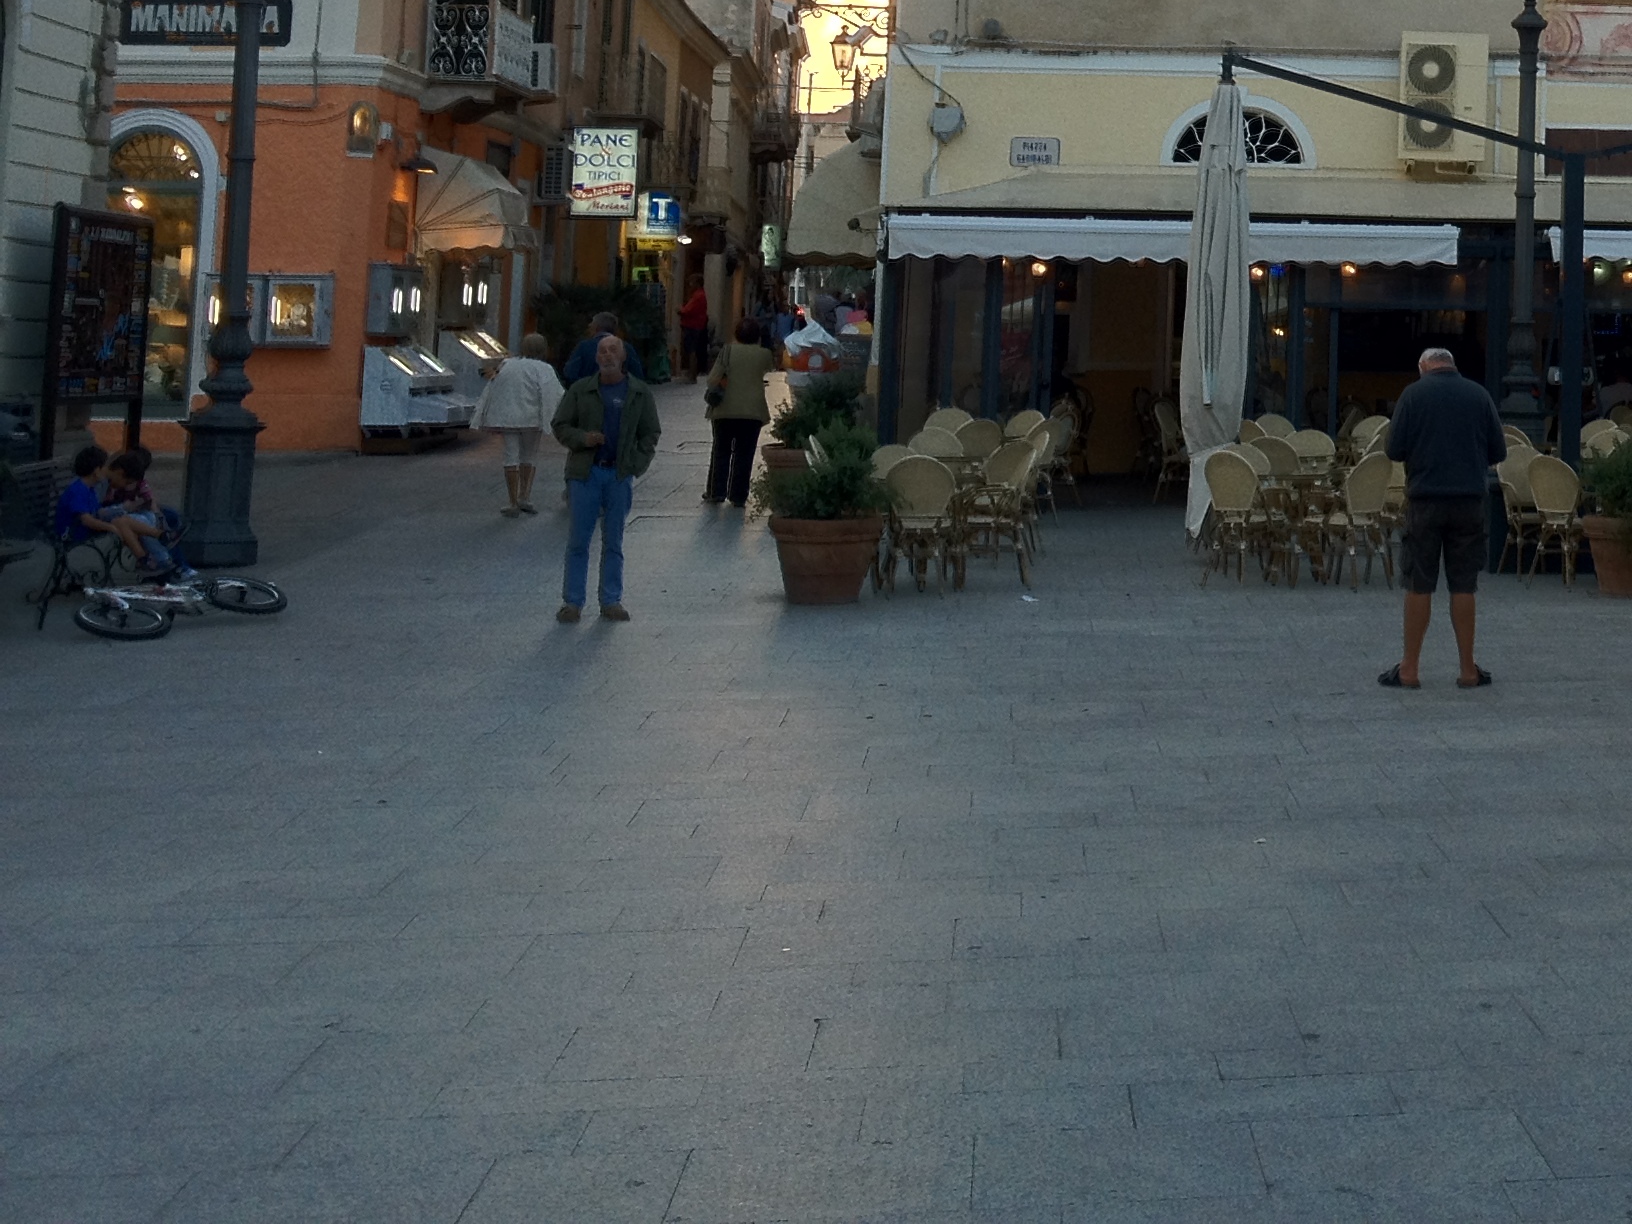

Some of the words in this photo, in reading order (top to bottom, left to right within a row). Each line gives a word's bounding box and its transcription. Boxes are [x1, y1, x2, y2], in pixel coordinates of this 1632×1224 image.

[580, 133, 633, 148] PANE
[574, 153, 636, 168] DOLCI
[587, 170, 620, 181] TIPICI
